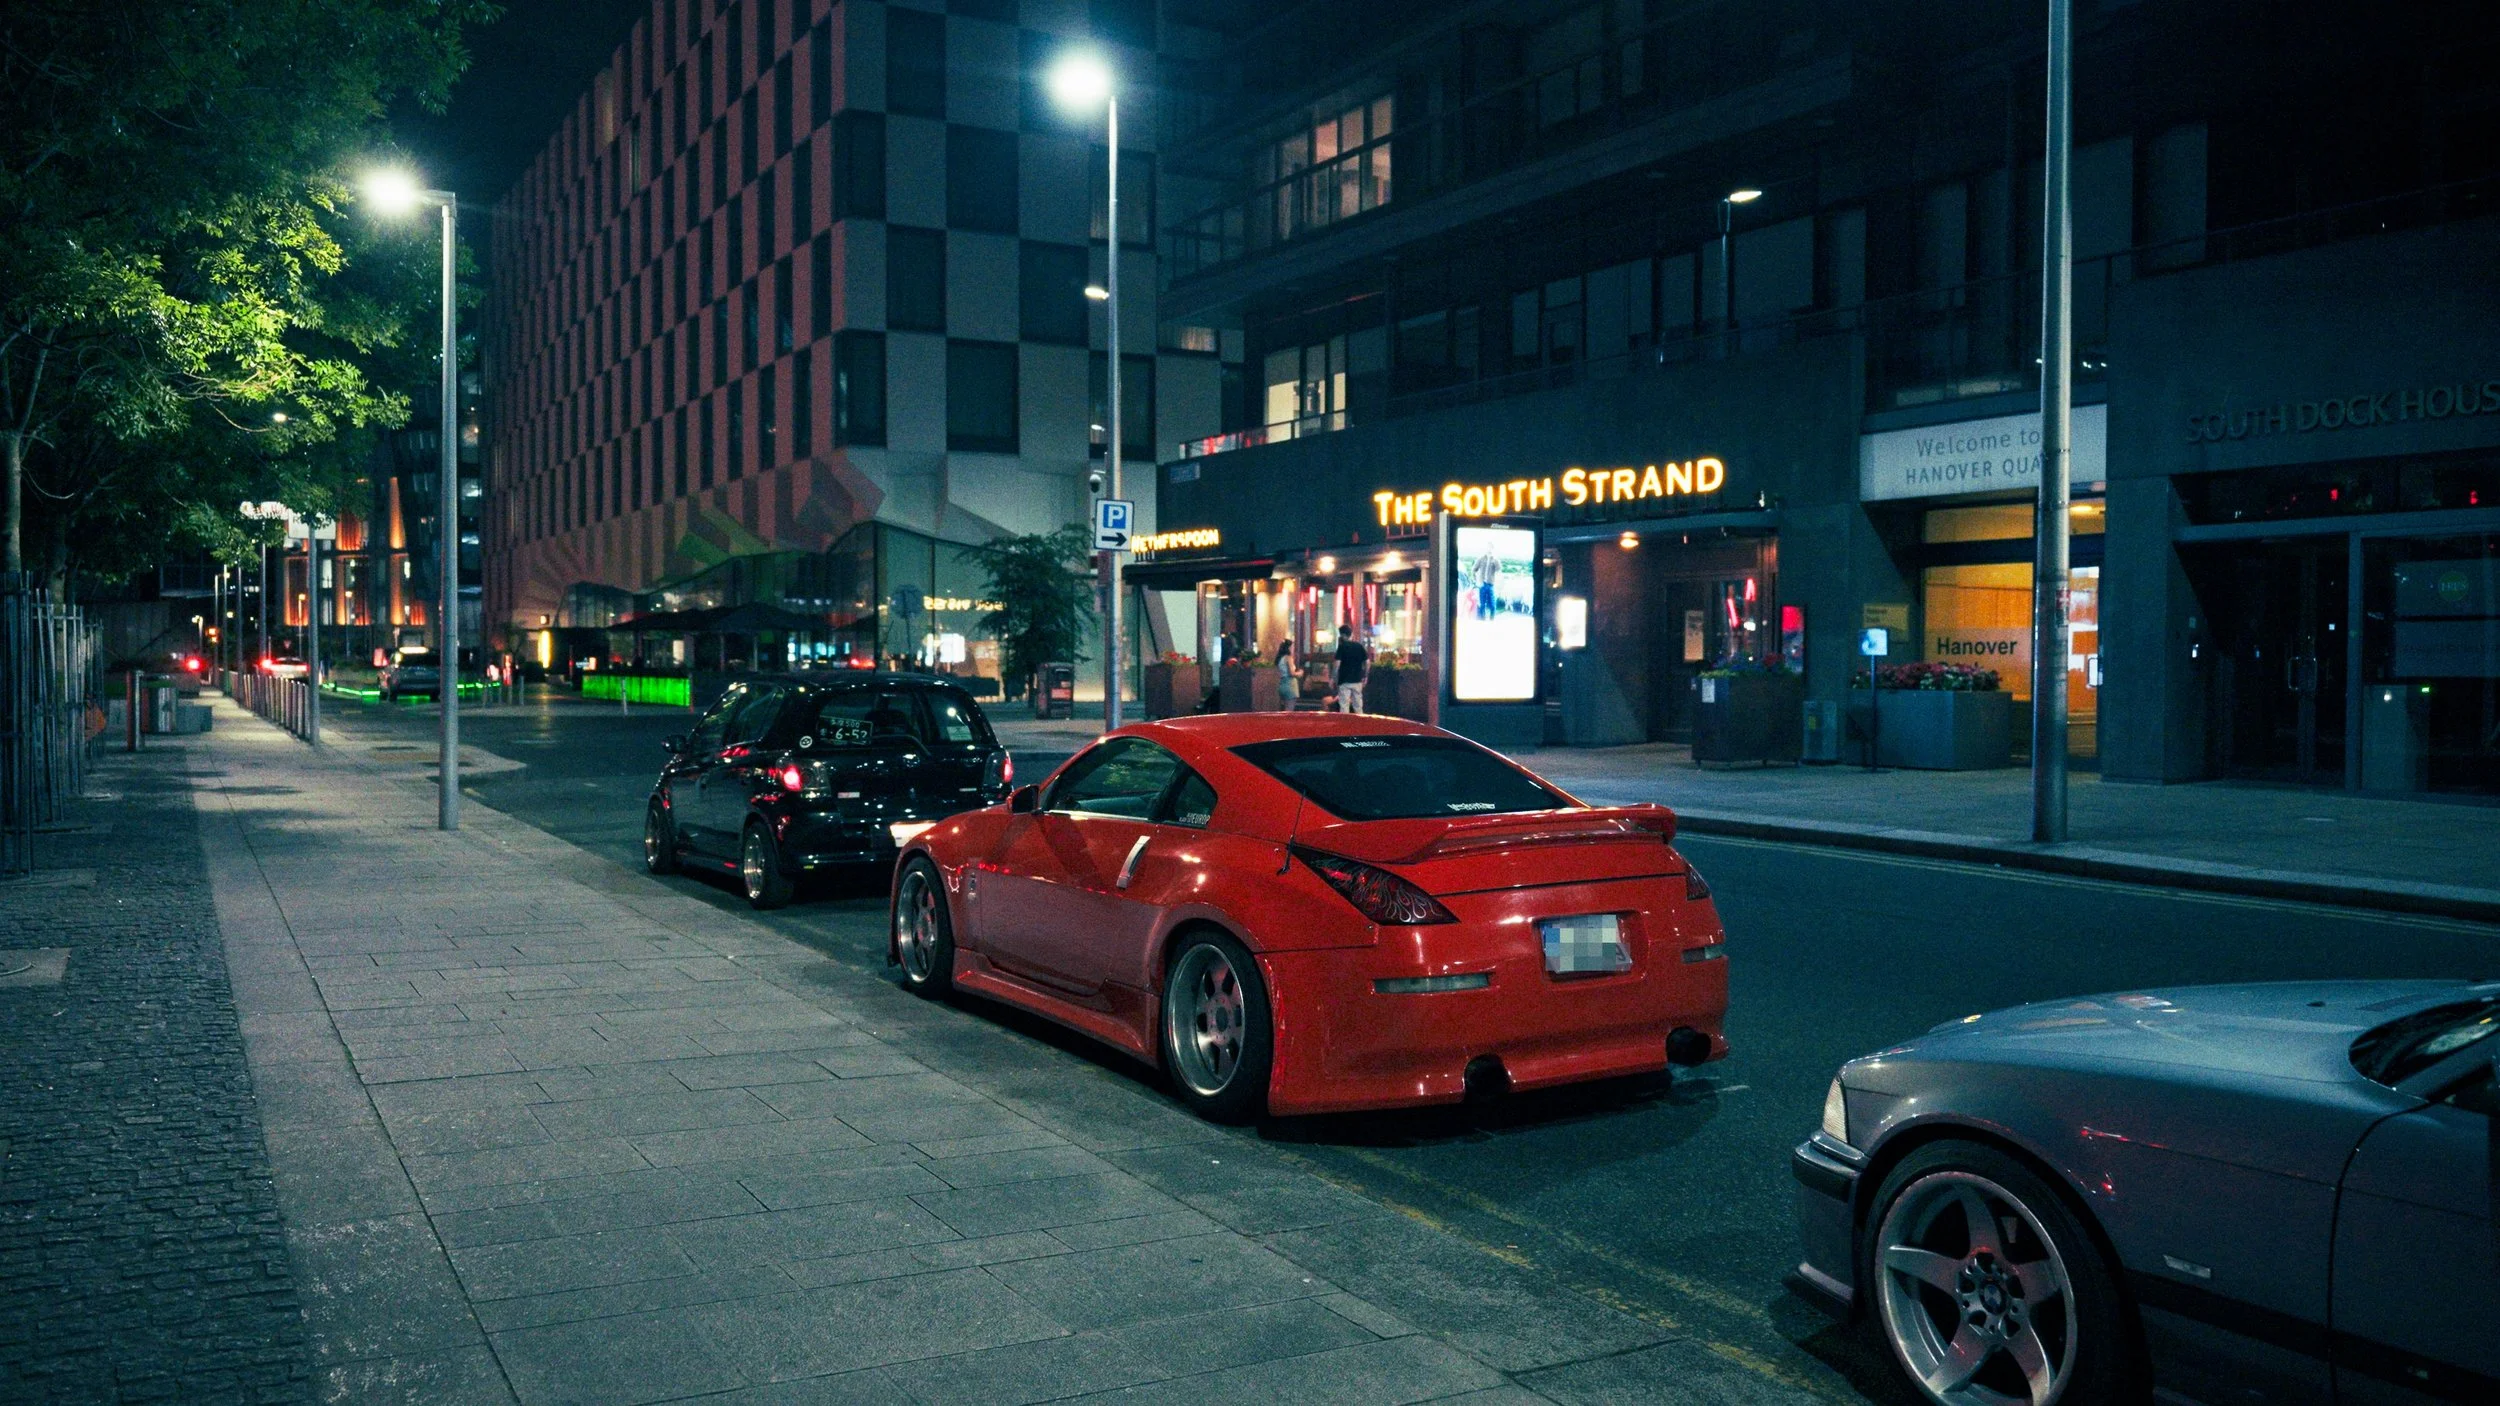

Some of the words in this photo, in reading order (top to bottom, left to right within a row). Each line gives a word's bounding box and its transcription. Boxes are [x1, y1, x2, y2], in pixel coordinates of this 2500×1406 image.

[2185, 402, 2288, 444] SOUTH
[2296, 393, 2394, 433] DOCK
[2399, 380, 2500, 421] HOUS
[1916, 433, 2011, 457] Welcome
[2020, 430, 2041, 446] to
[1905, 460, 1993, 485] HANOVER
[2002, 456, 2041, 478] QUA
[1374, 491, 1433, 527] THE
[1442, 477, 1553, 517] SOUTH
[1562, 458, 1725, 506] STRAND
[1107, 505, 1125, 528] P
[1937, 637, 2018, 655] Hanover
